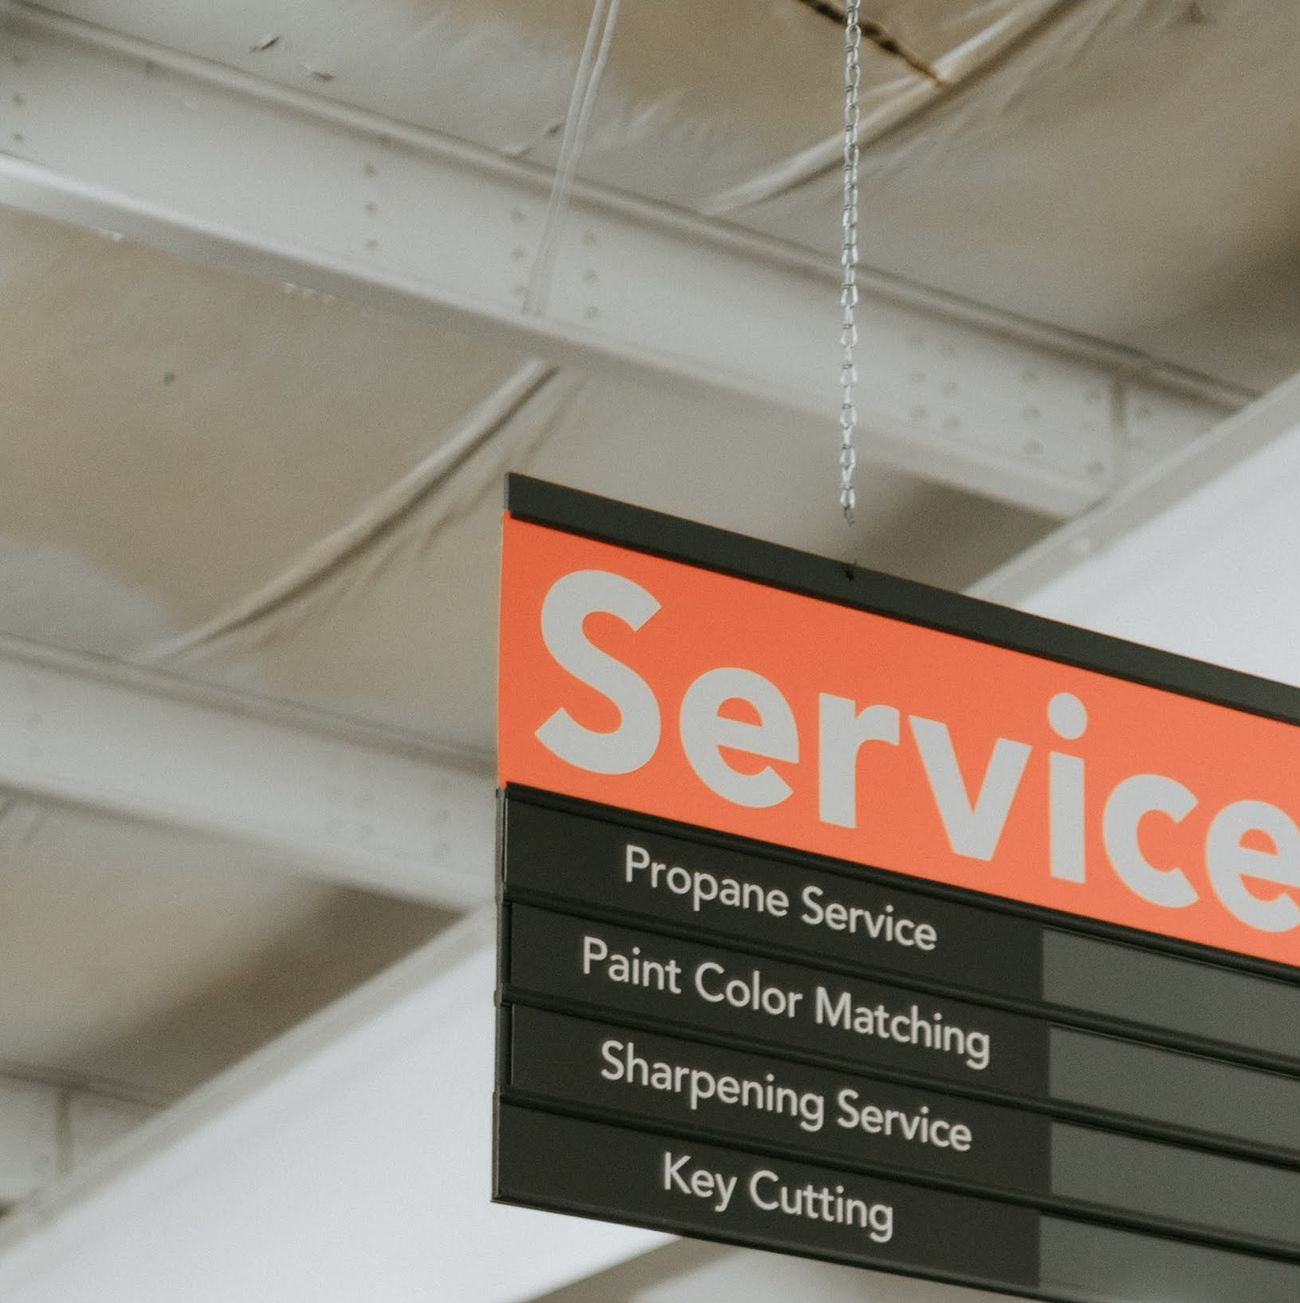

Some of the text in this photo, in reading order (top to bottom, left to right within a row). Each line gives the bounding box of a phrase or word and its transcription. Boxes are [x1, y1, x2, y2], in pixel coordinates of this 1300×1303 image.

[625, 844, 937, 951] Propane Service
[582, 936, 990, 1070] Paint Color Matching
[601, 1040, 972, 1151] Sharpening Service
[663, 1152, 894, 1243] Key Cutting
